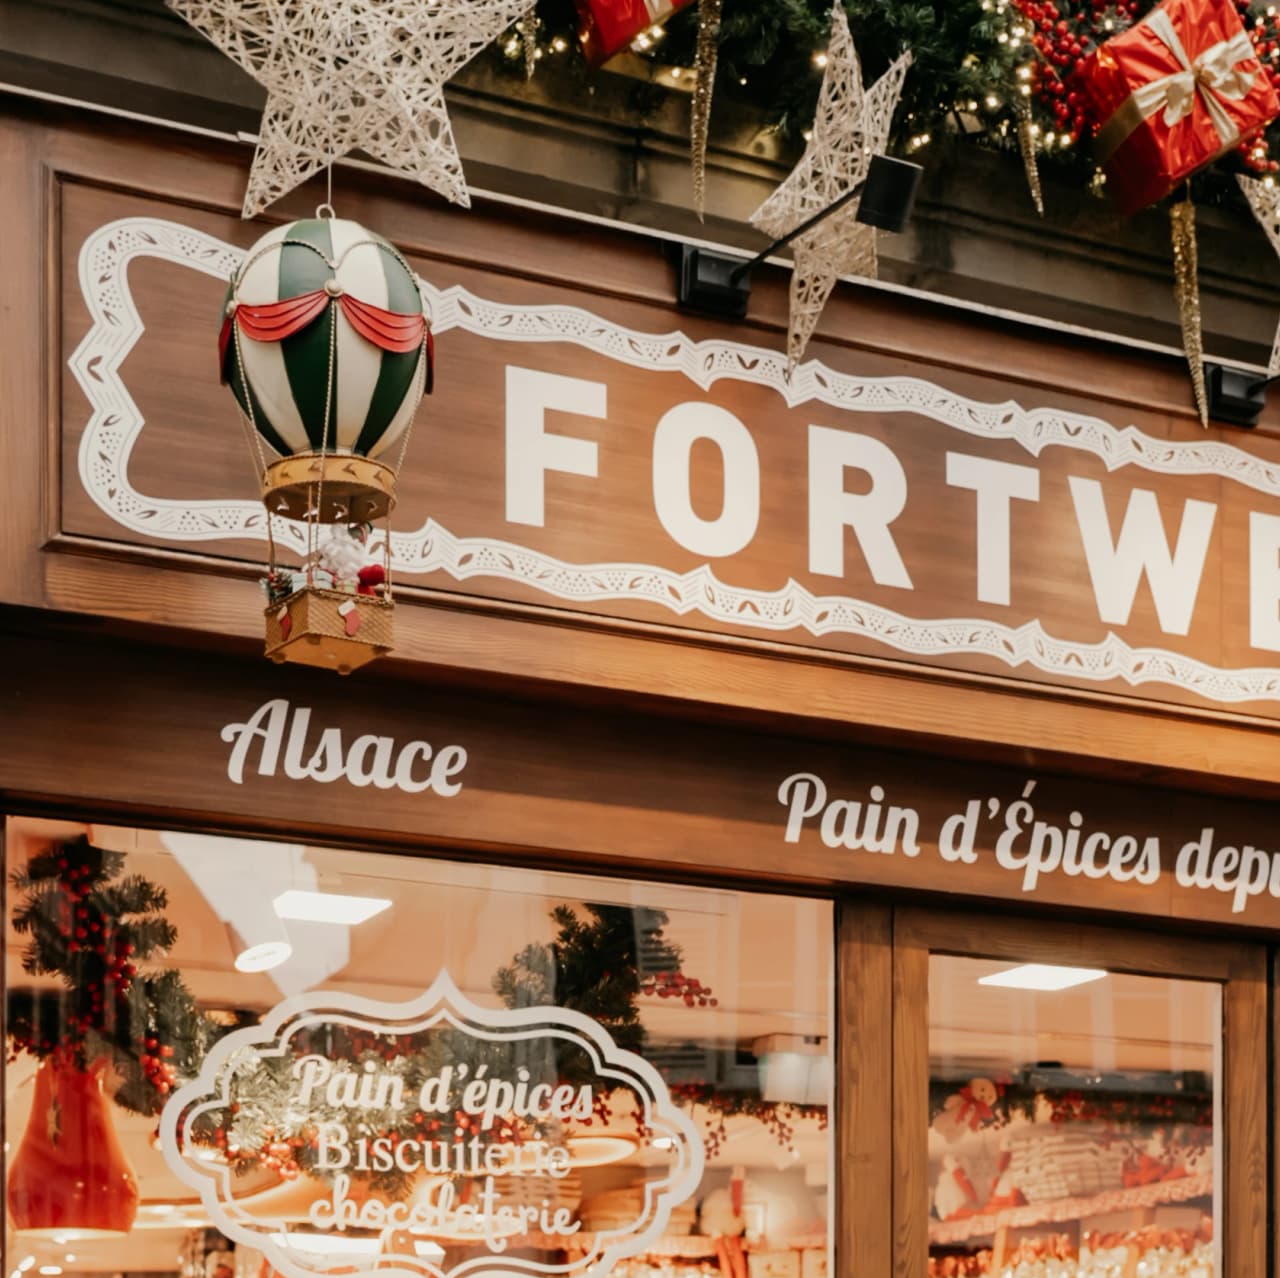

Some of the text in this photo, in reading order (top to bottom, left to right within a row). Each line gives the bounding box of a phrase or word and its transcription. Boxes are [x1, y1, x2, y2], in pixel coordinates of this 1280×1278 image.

[220, 698, 468, 797] Alsace
[777, 773, 921, 858] Pain
[938, 780, 1162, 893] d'Épices
[293, 1054, 594, 1130] Pain d'épices
[313, 1121, 572, 1178] Biscuiterie
[309, 1173, 582, 1253] chocolaterie
